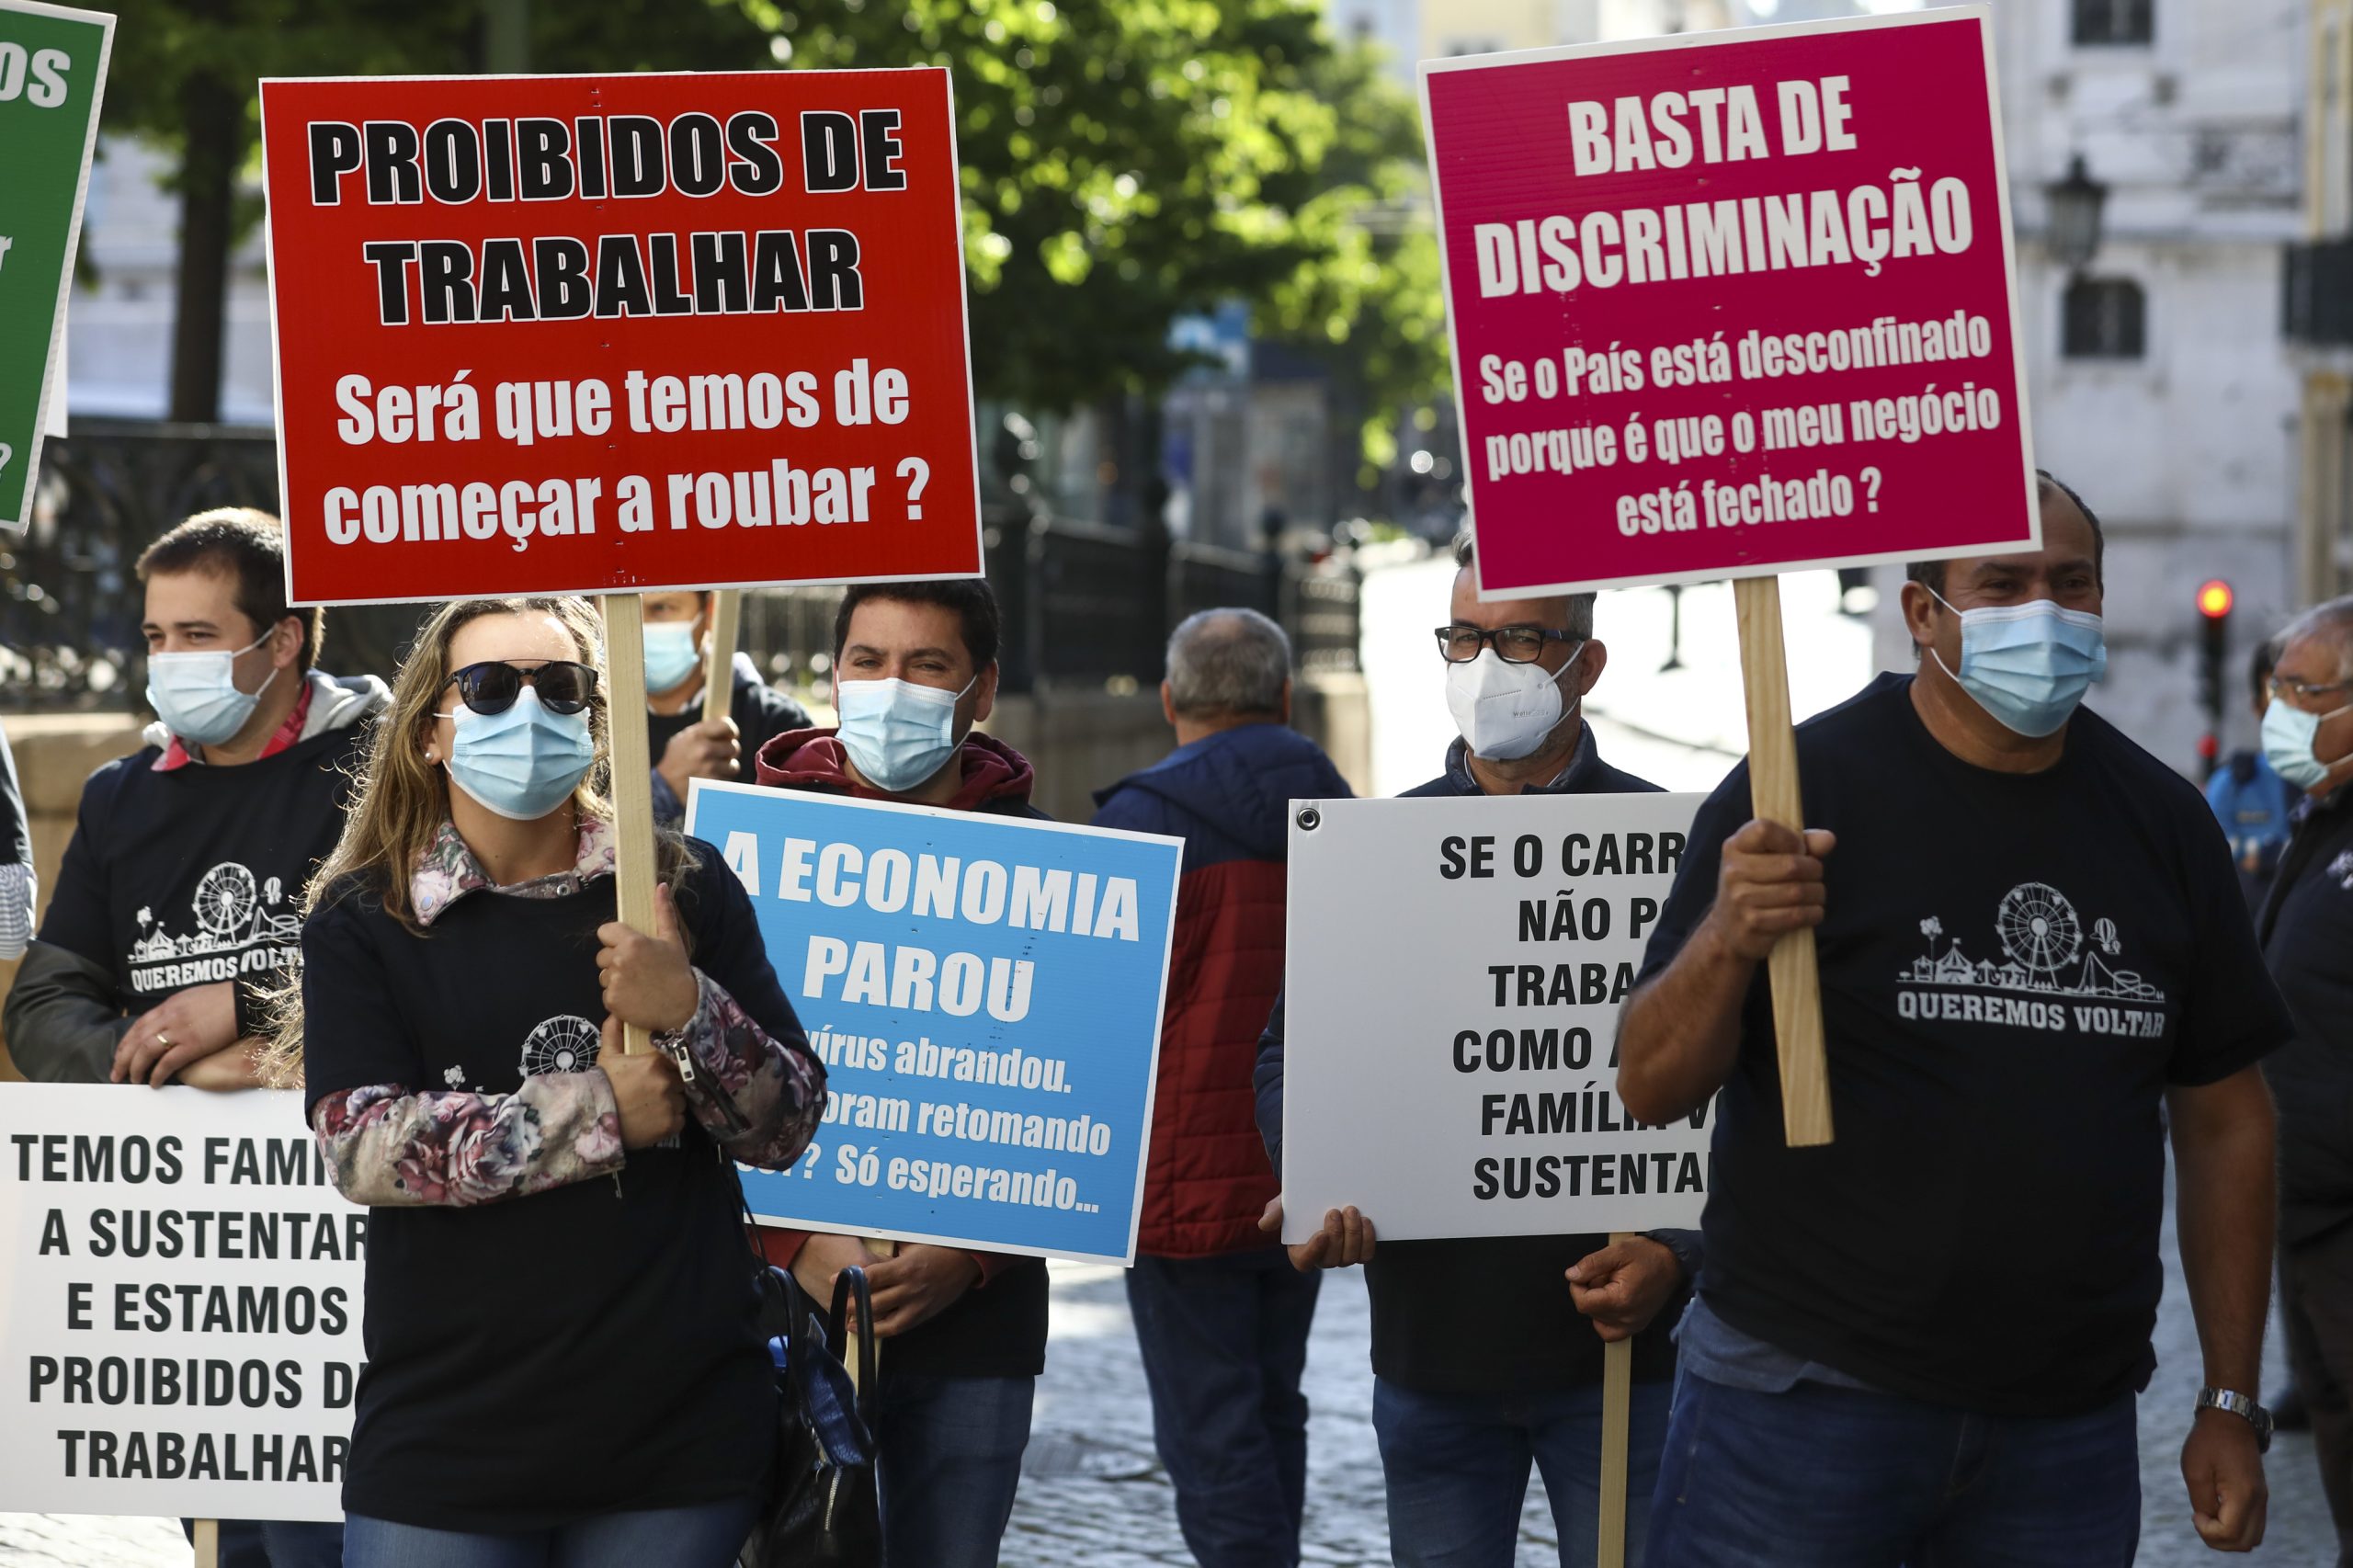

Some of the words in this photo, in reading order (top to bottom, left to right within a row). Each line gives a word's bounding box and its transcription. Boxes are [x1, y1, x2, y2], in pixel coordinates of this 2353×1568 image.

[1568, 85, 1769, 176] BASTA
[1777, 74, 1857, 156] DE
[307, 110, 783, 207] PROIBIDOS
[800, 108, 908, 193] DE
[1473, 166, 1972, 299] DISCRIMINAÇÃO
[363, 228, 865, 326] TRABALHAR
[1480, 355, 1528, 404] Se
[1534, 358, 1558, 399] o
[1563, 341, 1644, 396] País
[1650, 331, 1732, 388] está
[1737, 309, 1991, 380] desconfinado
[335, 369, 481, 446] Será
[495, 379, 612, 447] que
[625, 369, 820, 433] temos
[834, 358, 910, 426] de
[1485, 426, 1617, 482] porque
[1624, 412, 1648, 463] é
[1654, 415, 1724, 464] que
[1732, 412, 1755, 453] o
[1762, 404, 1844, 450] meu
[1850, 382, 2001, 444] negócio
[324, 476, 602, 552] começar
[616, 474, 654, 533] a
[668, 458, 876, 530] roubar
[895, 456, 930, 520] ?
[1616, 482, 1698, 537] está
[1702, 470, 1854, 528] fechado
[1860, 466, 1882, 513] ?
[1439, 835, 1495, 880] SE
[1514, 834, 1543, 879] O
[1562, 832, 1686, 876] CARR
[722, 830, 760, 897] A
[778, 837, 1140, 942] ECONOMIA
[1518, 888, 1611, 942] NÃO
[1630, 897, 1669, 939] P
[131, 956, 239, 993] QUEREMOS
[802, 935, 1035, 1023] PAROU
[1897, 991, 2066, 1031] QUEREMOS
[2074, 1006, 2165, 1038] VOLTAR
[894, 1037, 1073, 1094] abrandou.
[1453, 1027, 1592, 1074] COMO
[916, 1102, 1111, 1156] retomando
[1481, 1081, 1666, 1136] FAMÍLI
[11, 1134, 182, 1185] TEMOS
[835, 1143, 880, 1187] Só
[887, 1157, 1100, 1213] esperando...
[1473, 1152, 1711, 1200] SUSTENTA
[40, 1209, 70, 1256] A
[89, 1209, 369, 1261] SUSTENTAR
[68, 1283, 93, 1330] E
[115, 1283, 347, 1335] ESTAMOS
[29, 1356, 301, 1409] PROIBIDOS
[324, 1362, 369, 1409] D
[57, 1430, 350, 1483] TRABALHAR
